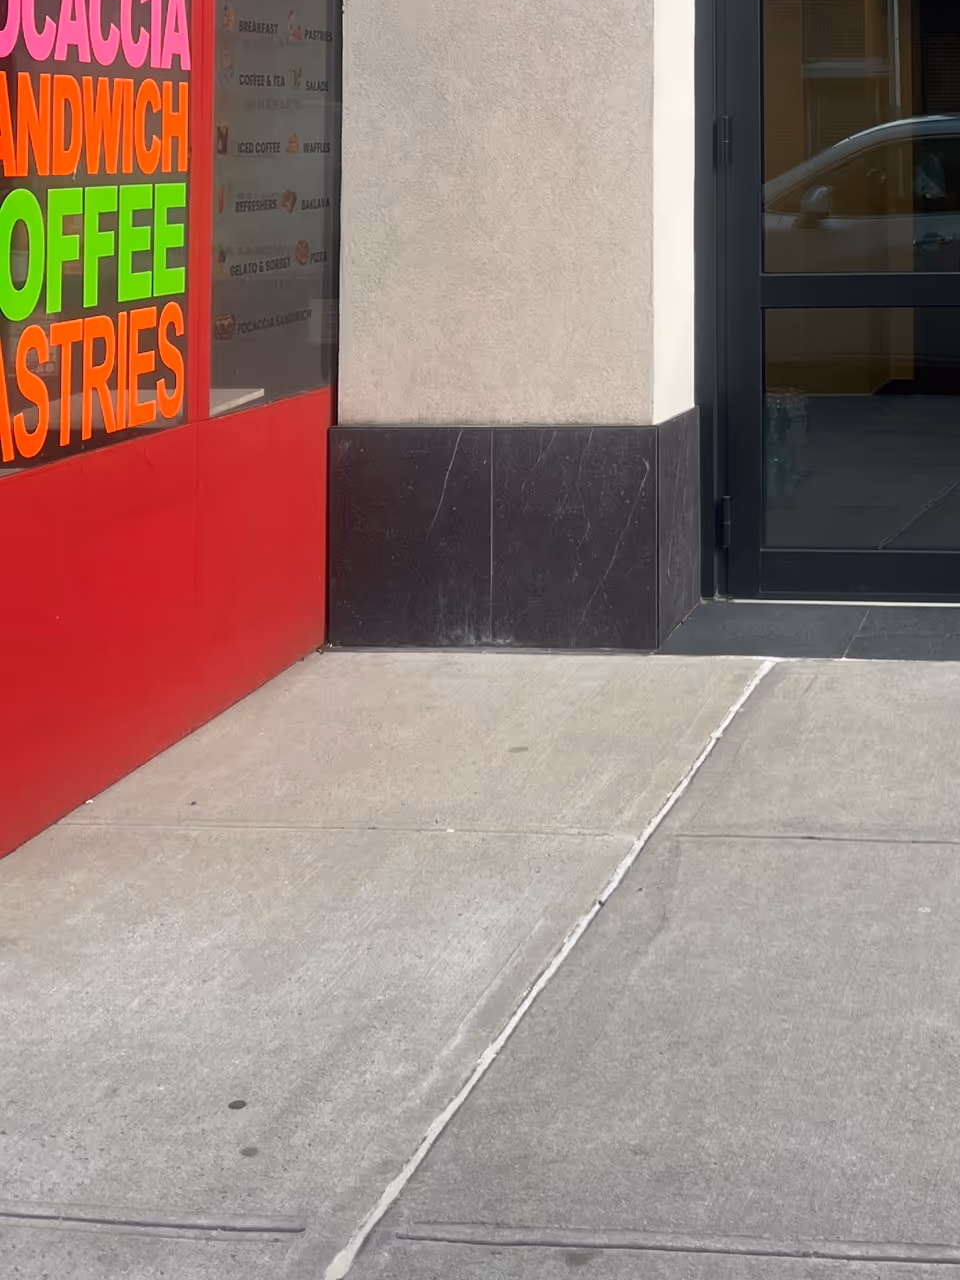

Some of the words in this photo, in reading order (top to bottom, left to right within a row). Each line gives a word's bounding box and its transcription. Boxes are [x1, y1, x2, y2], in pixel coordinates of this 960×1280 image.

[239, 20, 279, 35] BREAKFAST
[239, 74, 265, 87] COFFEE
[266, 75, 272, 87] &
[273, 75, 286, 88] TEA
[237, 142, 254, 154] ICED
[255, 142, 281, 154] COFFEE
[303, 142, 331, 154] WAFFLES
[235, 199, 278, 213] REFRESHERS
[229, 262, 258, 277] GELATO
[265, 257, 291, 272] SORBET
[275, 309, 313, 327] SANICH
